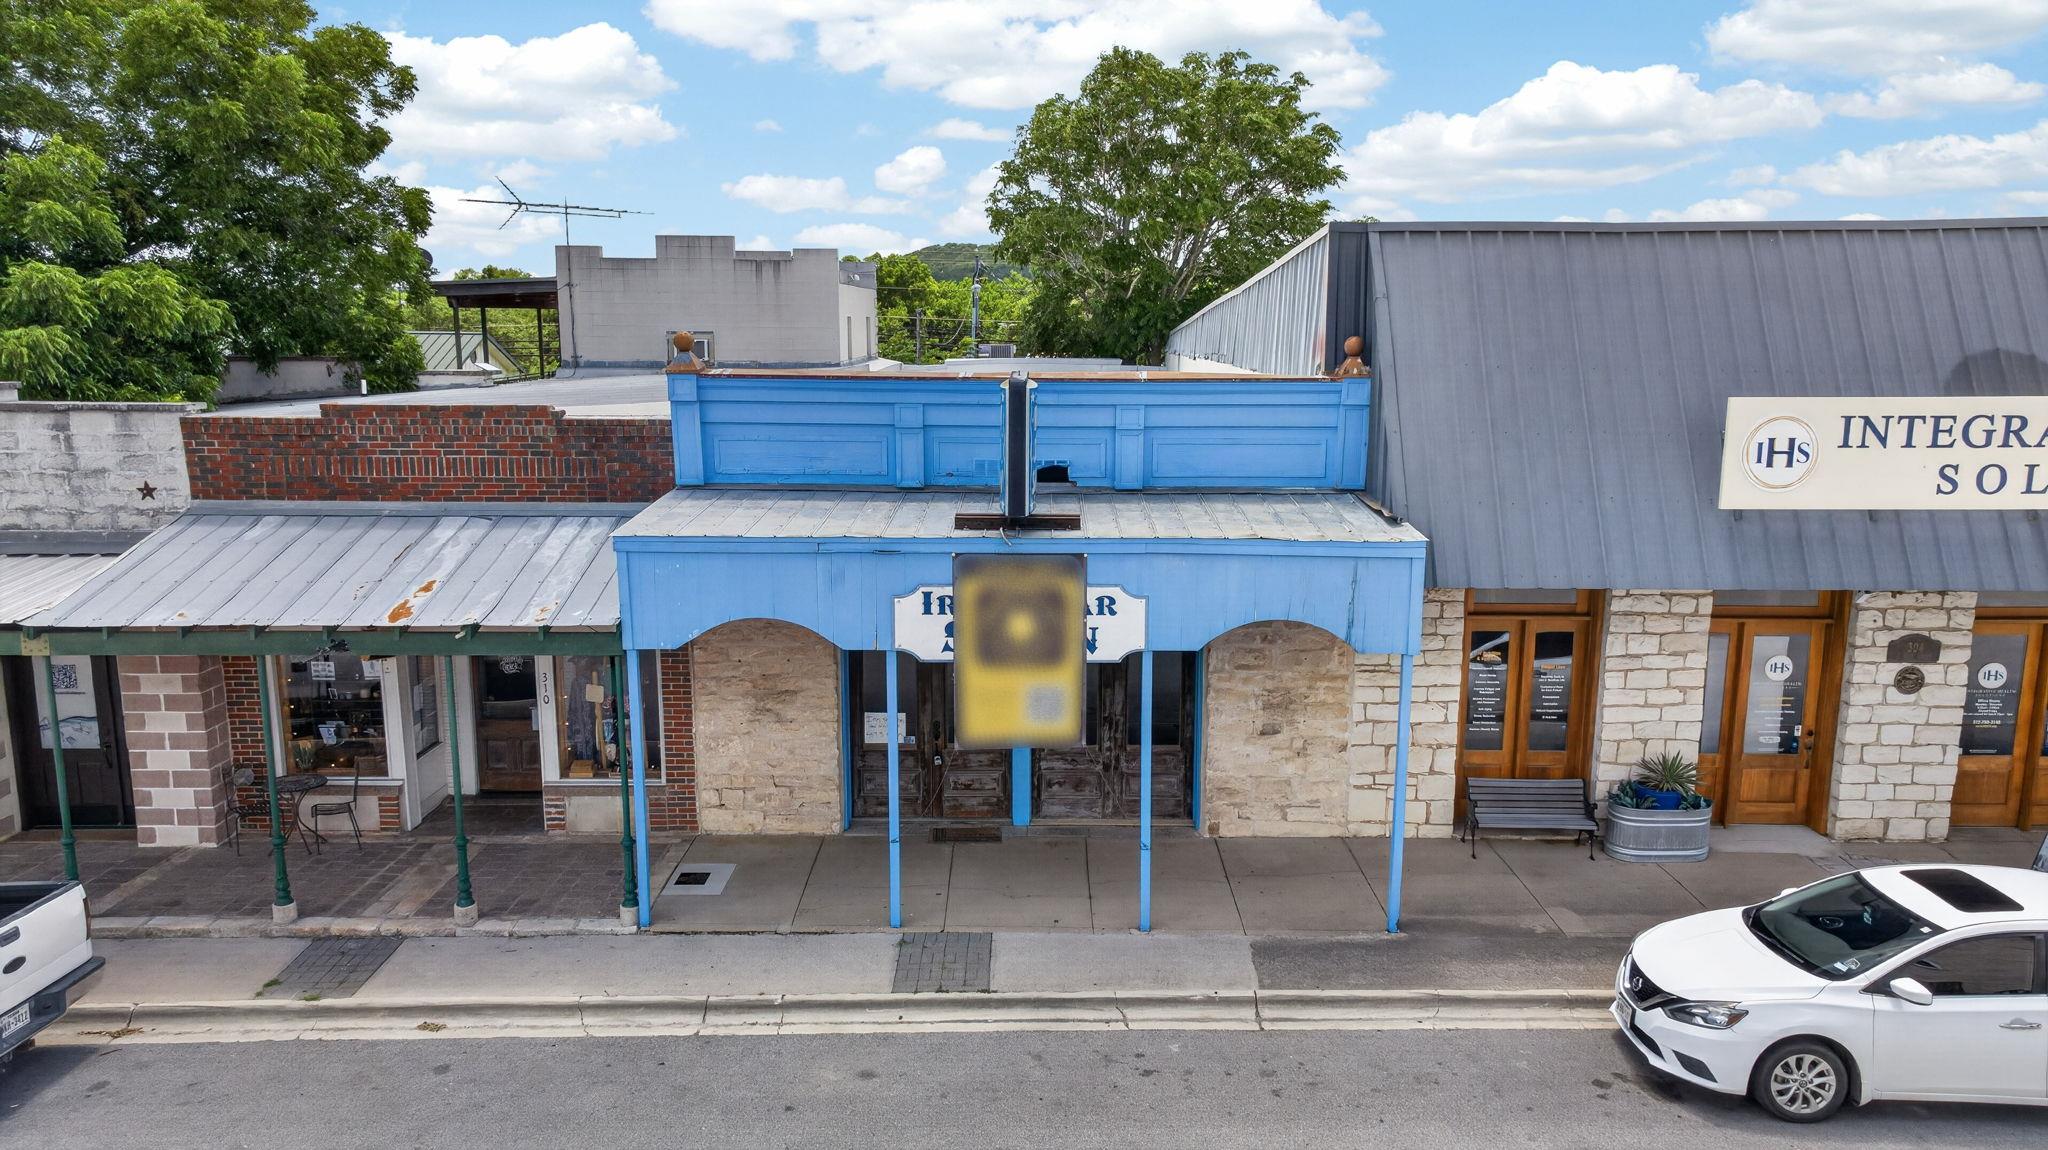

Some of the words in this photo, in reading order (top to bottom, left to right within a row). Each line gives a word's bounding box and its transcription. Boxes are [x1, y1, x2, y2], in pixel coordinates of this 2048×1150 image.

[1755, 437, 1810, 469] IHS
[1770, 662, 1790, 674] IHS
[1983, 670, 2004, 681] IHS
[542, 672, 550, 705] 310
